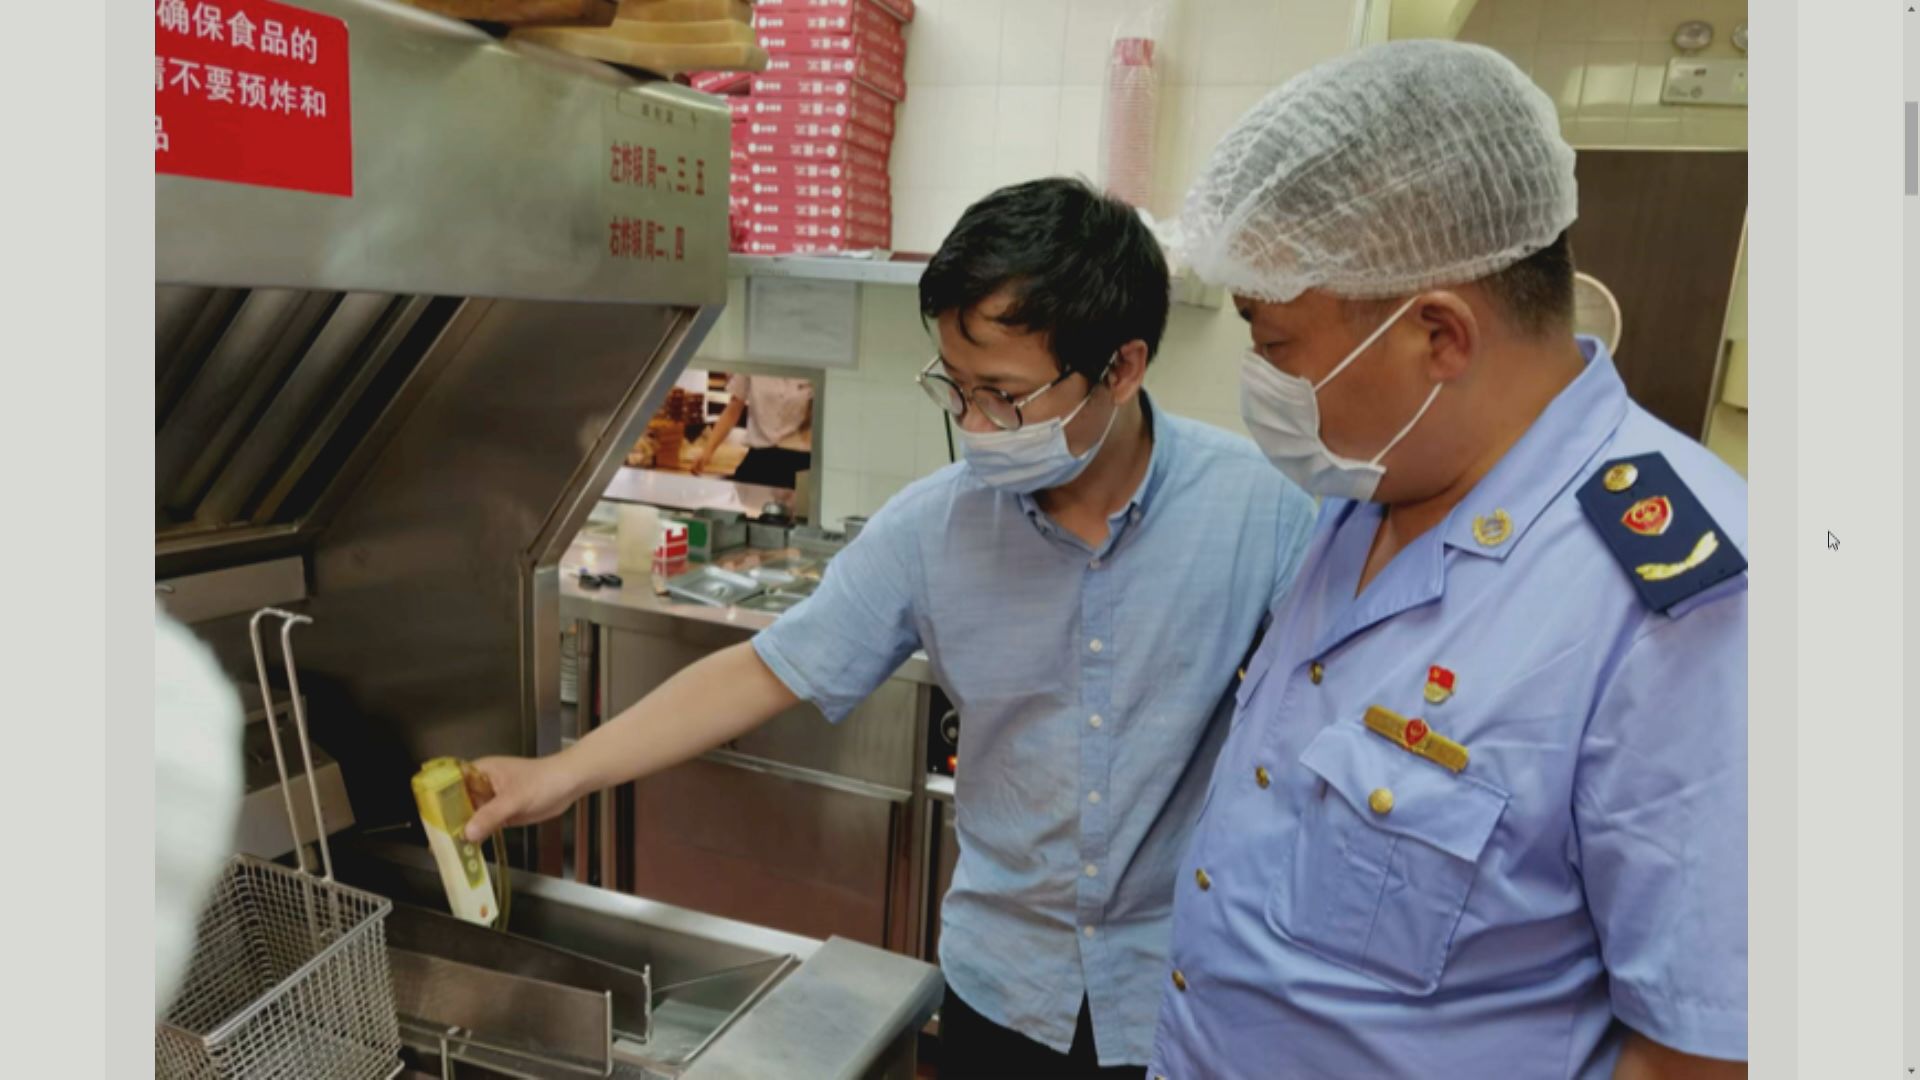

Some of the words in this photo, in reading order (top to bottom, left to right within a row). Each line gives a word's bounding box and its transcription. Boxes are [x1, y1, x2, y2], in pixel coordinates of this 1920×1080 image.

[157, 0, 318, 64] 确保食品的
